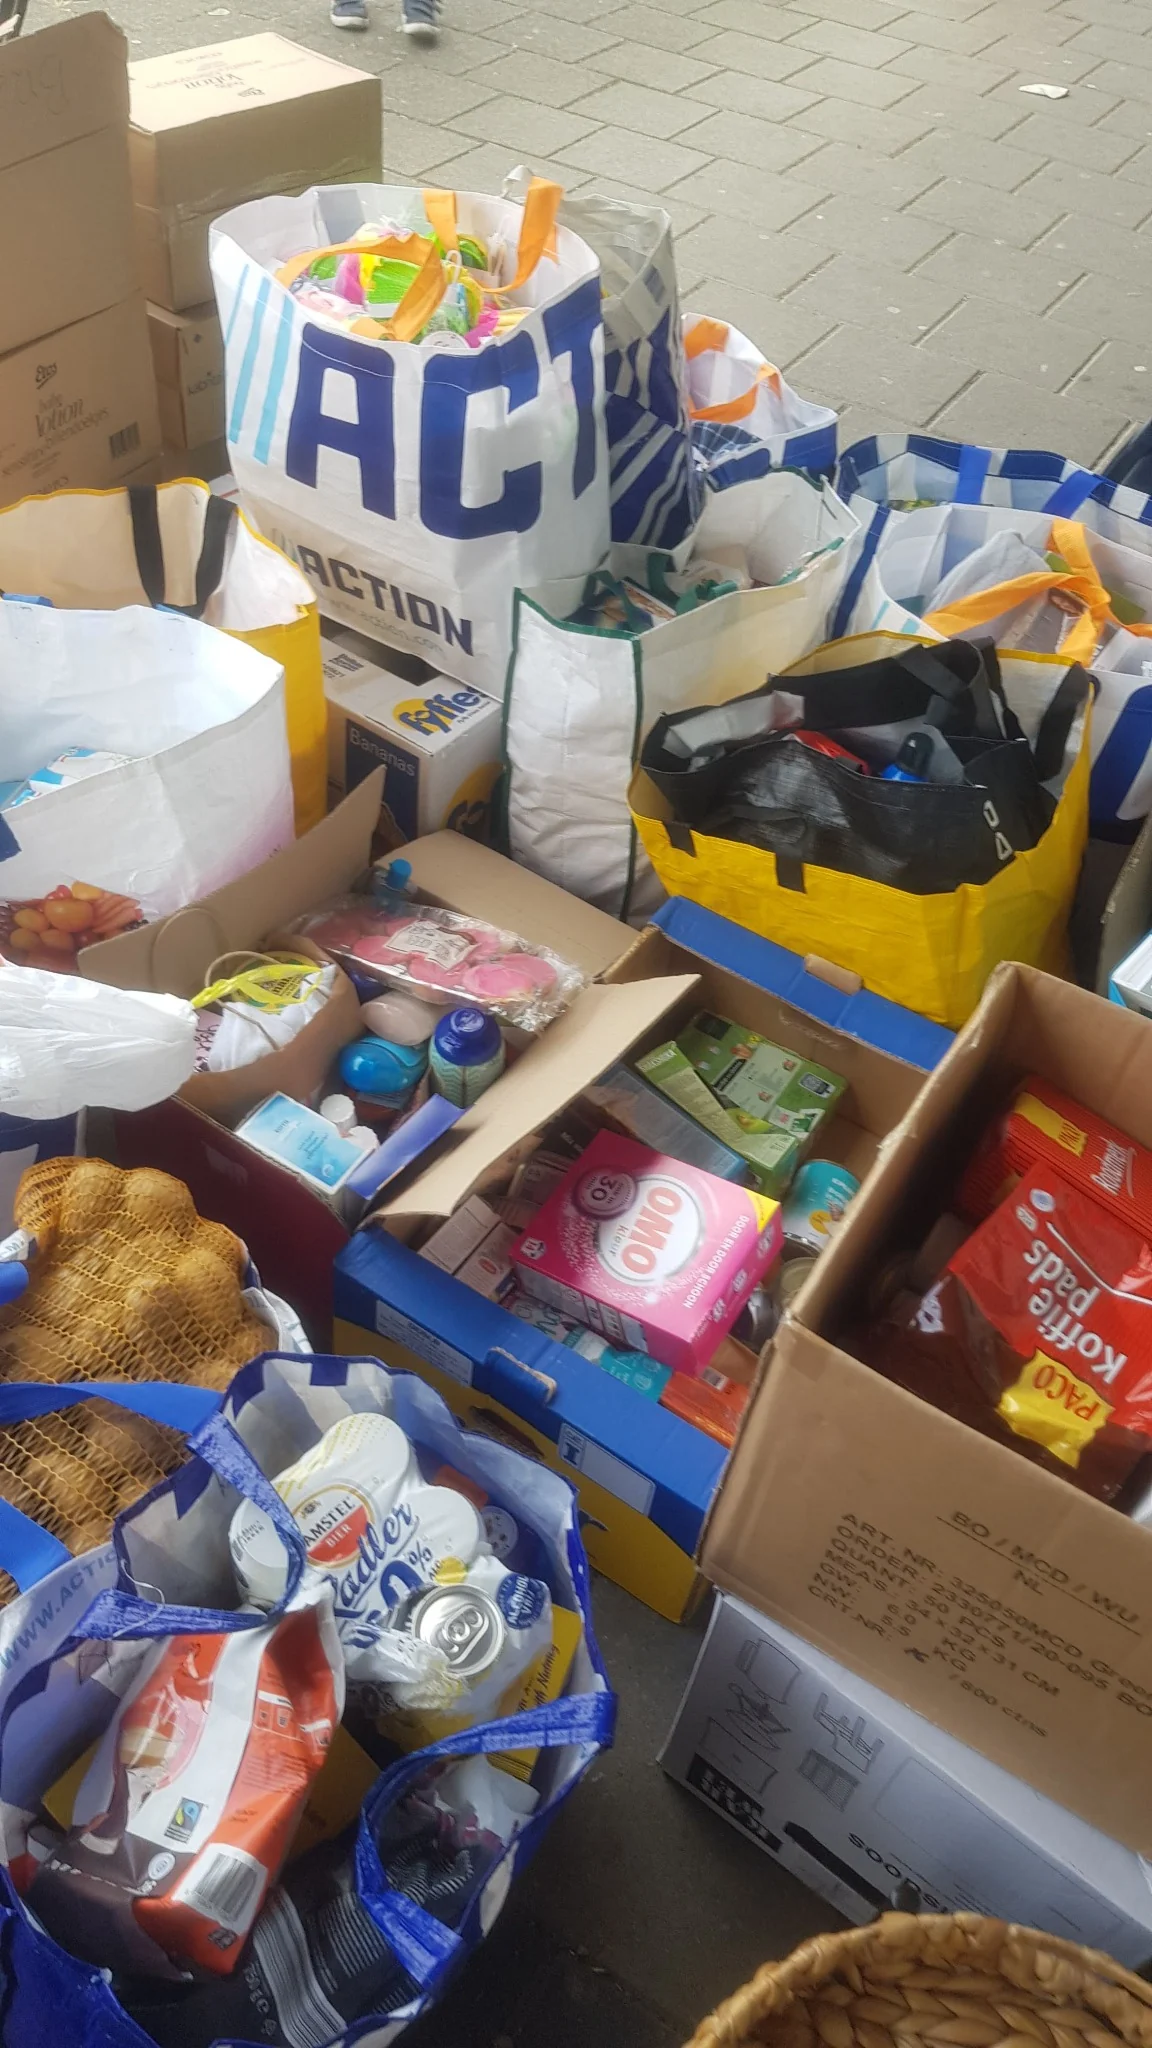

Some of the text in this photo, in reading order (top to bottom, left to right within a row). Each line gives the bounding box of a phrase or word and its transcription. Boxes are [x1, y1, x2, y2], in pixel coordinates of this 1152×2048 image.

[297, 544, 474, 656] ACTION
[350, 727, 416, 777] Bananas
[591, 1175, 617, 1201] 30
[608, 1224, 630, 1258] kleur
[621, 1186, 683, 1275] OMO
[719, 1235, 736, 1253] EN
[728, 1214, 751, 1241] DOOR
[704, 1249, 727, 1276] DOOR
[1023, 1239, 1101, 1318] pads
[682, 1271, 712, 1310] SCHOON
[1027, 1286, 1130, 1385] Koffie
[1033, 1363, 1100, 1423] PACO
[304, 1499, 356, 1548] AMSTEL
[325, 1524, 352, 1548] BIER
[836, 1524, 927, 1585] ORDER:
[951, 1510, 992, 1541] BO
[1010, 1544, 1071, 1586] MCD
[1090, 1590, 1140, 1626] WU
[923, 1594, 950, 1616] 50
[958, 1614, 1006, 1649] PCS
[932, 1646, 968, 1673] KG
[941, 1636, 977, 1663] KG
[1022, 1669, 1061, 1697] CM
